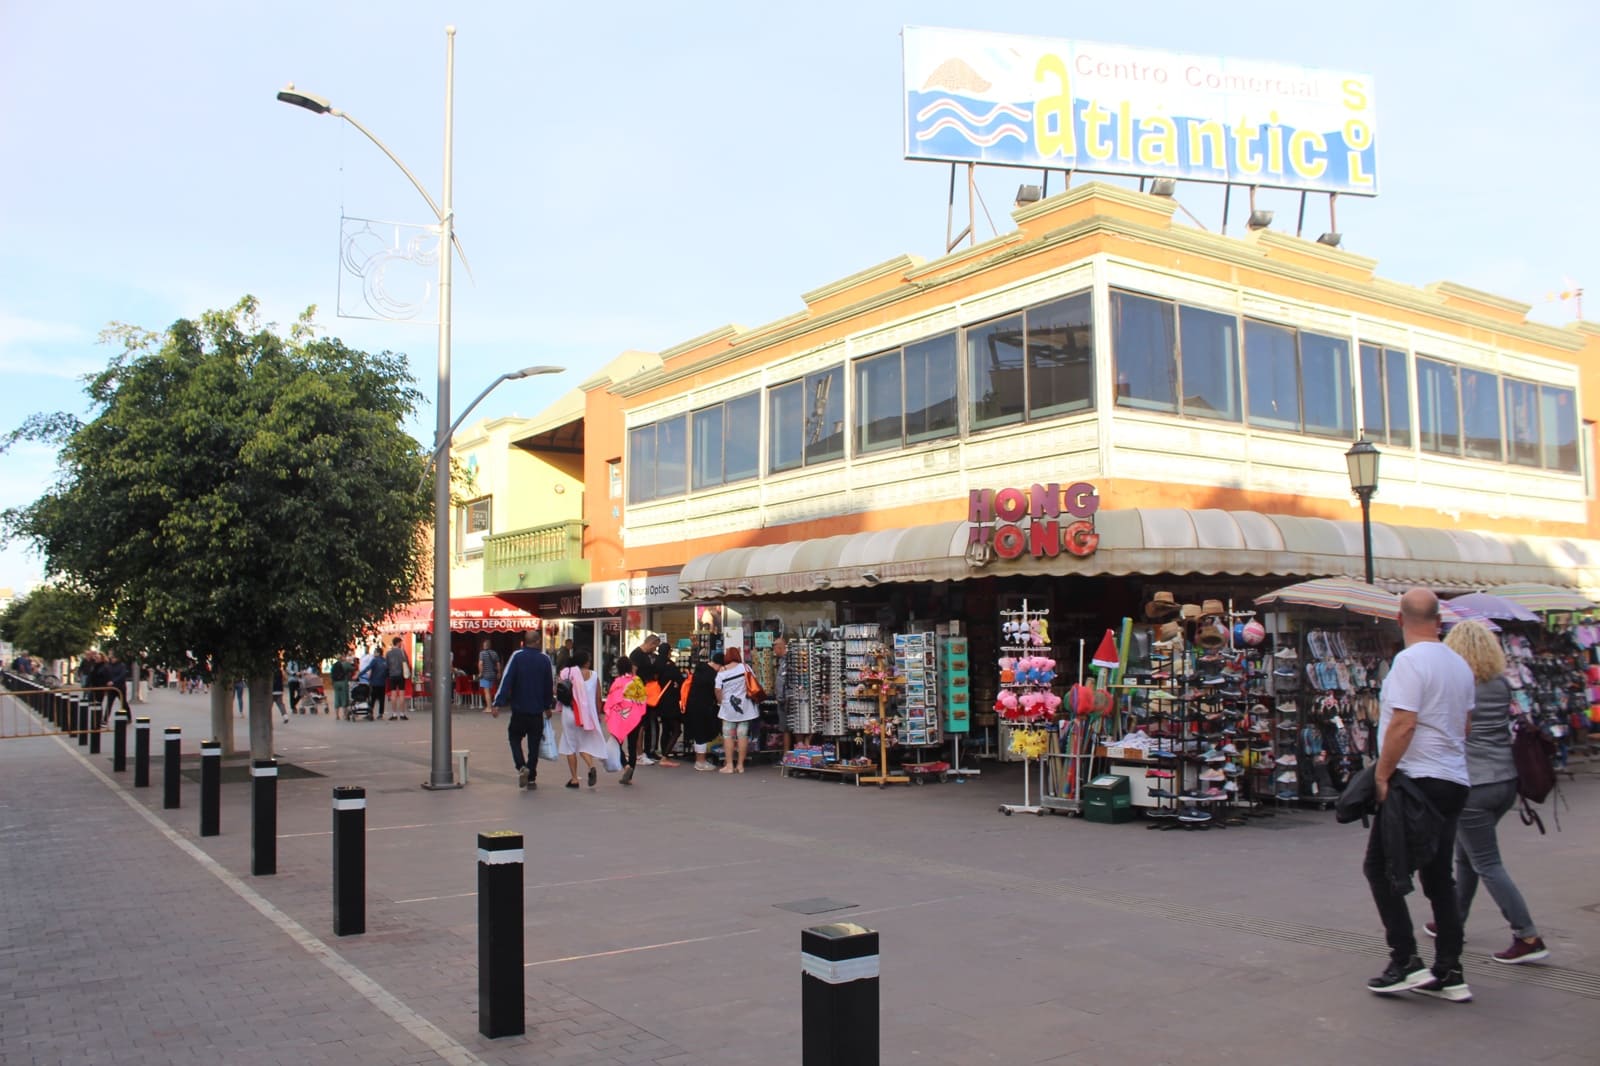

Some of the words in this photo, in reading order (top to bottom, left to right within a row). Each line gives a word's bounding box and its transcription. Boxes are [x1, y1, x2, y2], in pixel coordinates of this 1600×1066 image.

[1075, 54, 1168, 84] Centro
[1185, 66, 1319, 97] Comercial
[968, 482, 1100, 523] HONG
[650, 583, 670, 596] Optics
[482, 618, 538, 629] DEPORTIVAS
